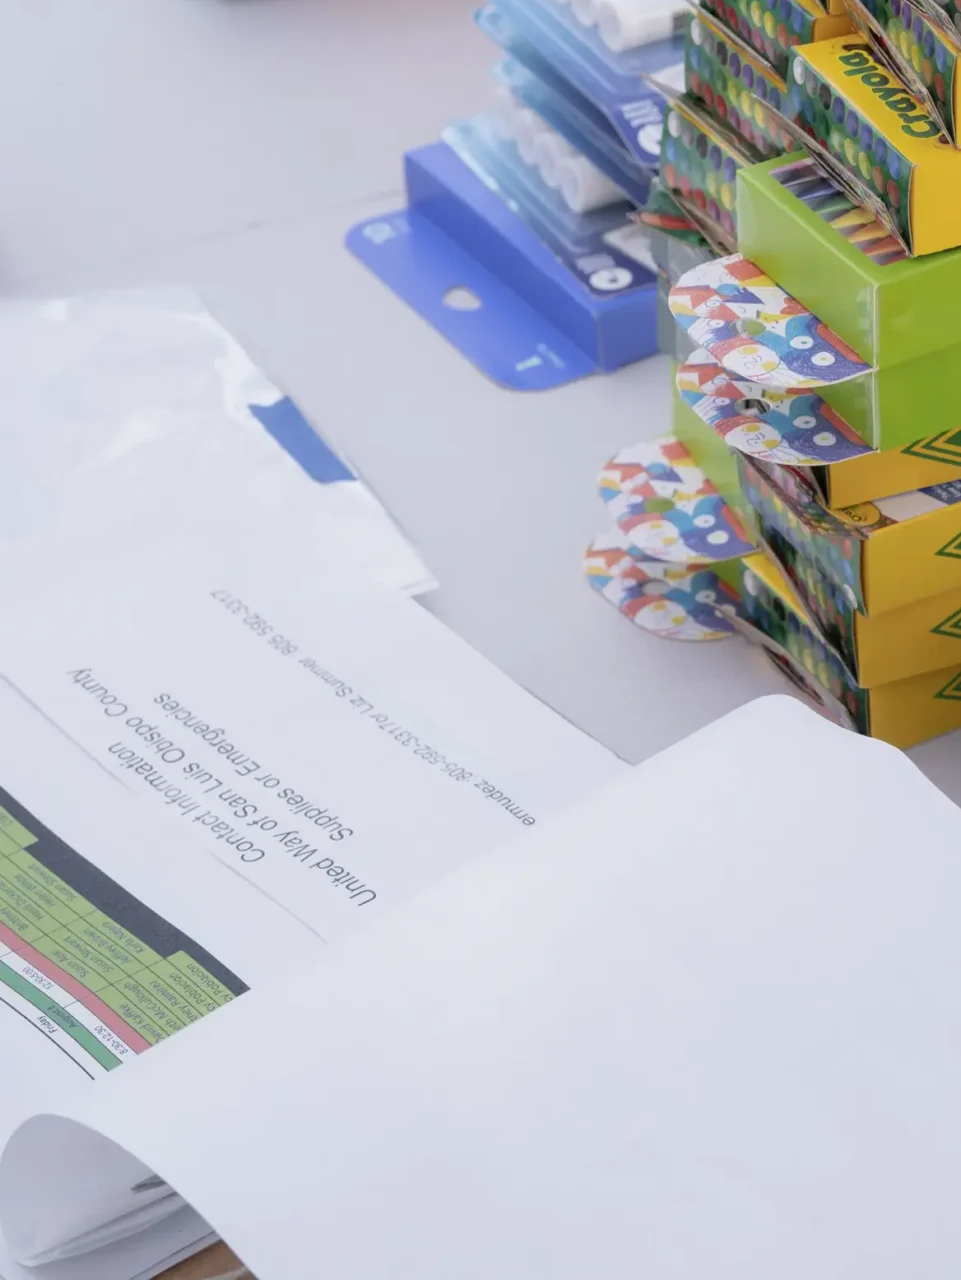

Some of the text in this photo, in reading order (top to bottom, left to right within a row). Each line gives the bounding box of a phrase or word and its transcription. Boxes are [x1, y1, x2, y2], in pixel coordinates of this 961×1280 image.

[838, 51, 941, 139] Crayola
[65, 667, 377, 907] United Way of San Luis Obispo County
[107, 741, 265, 863] Contact Information
[153, 693, 354, 842] Supplies or Emergencies
[36, 1015, 59, 1034] Friday
